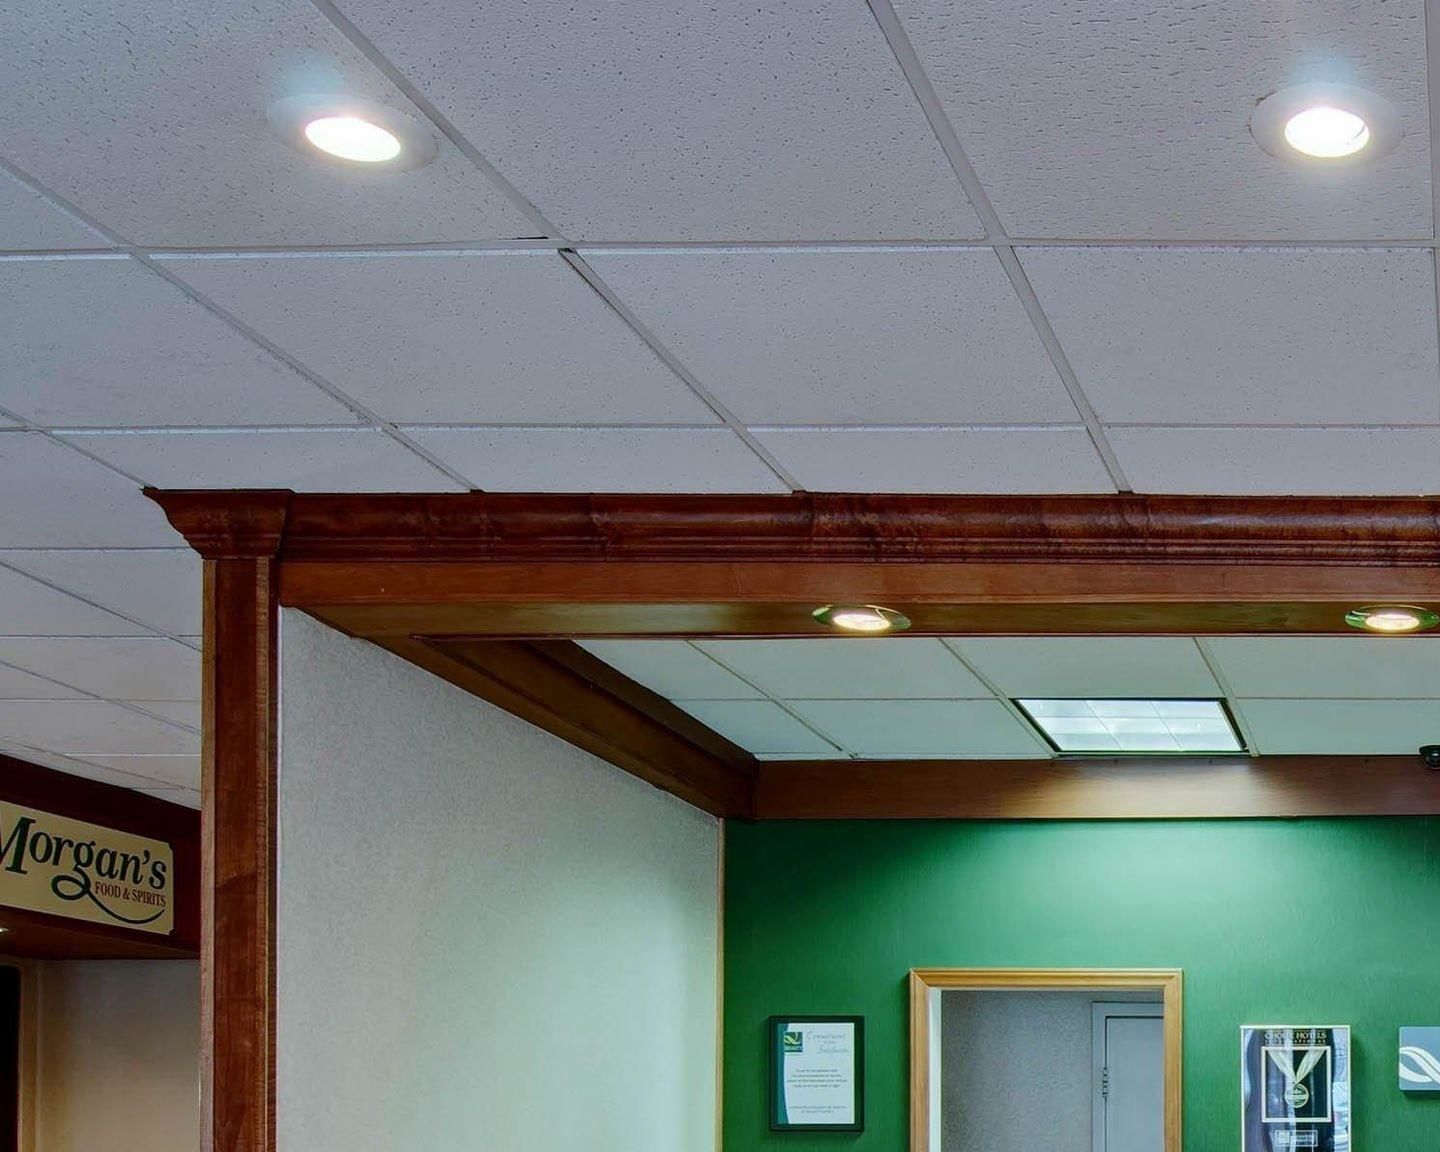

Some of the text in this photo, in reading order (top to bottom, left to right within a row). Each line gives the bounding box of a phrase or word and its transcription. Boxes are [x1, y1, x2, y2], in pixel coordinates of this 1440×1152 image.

[0, 816, 166, 924] Morgan's
[94, 881, 166, 908] FOOD & SPIRITS
